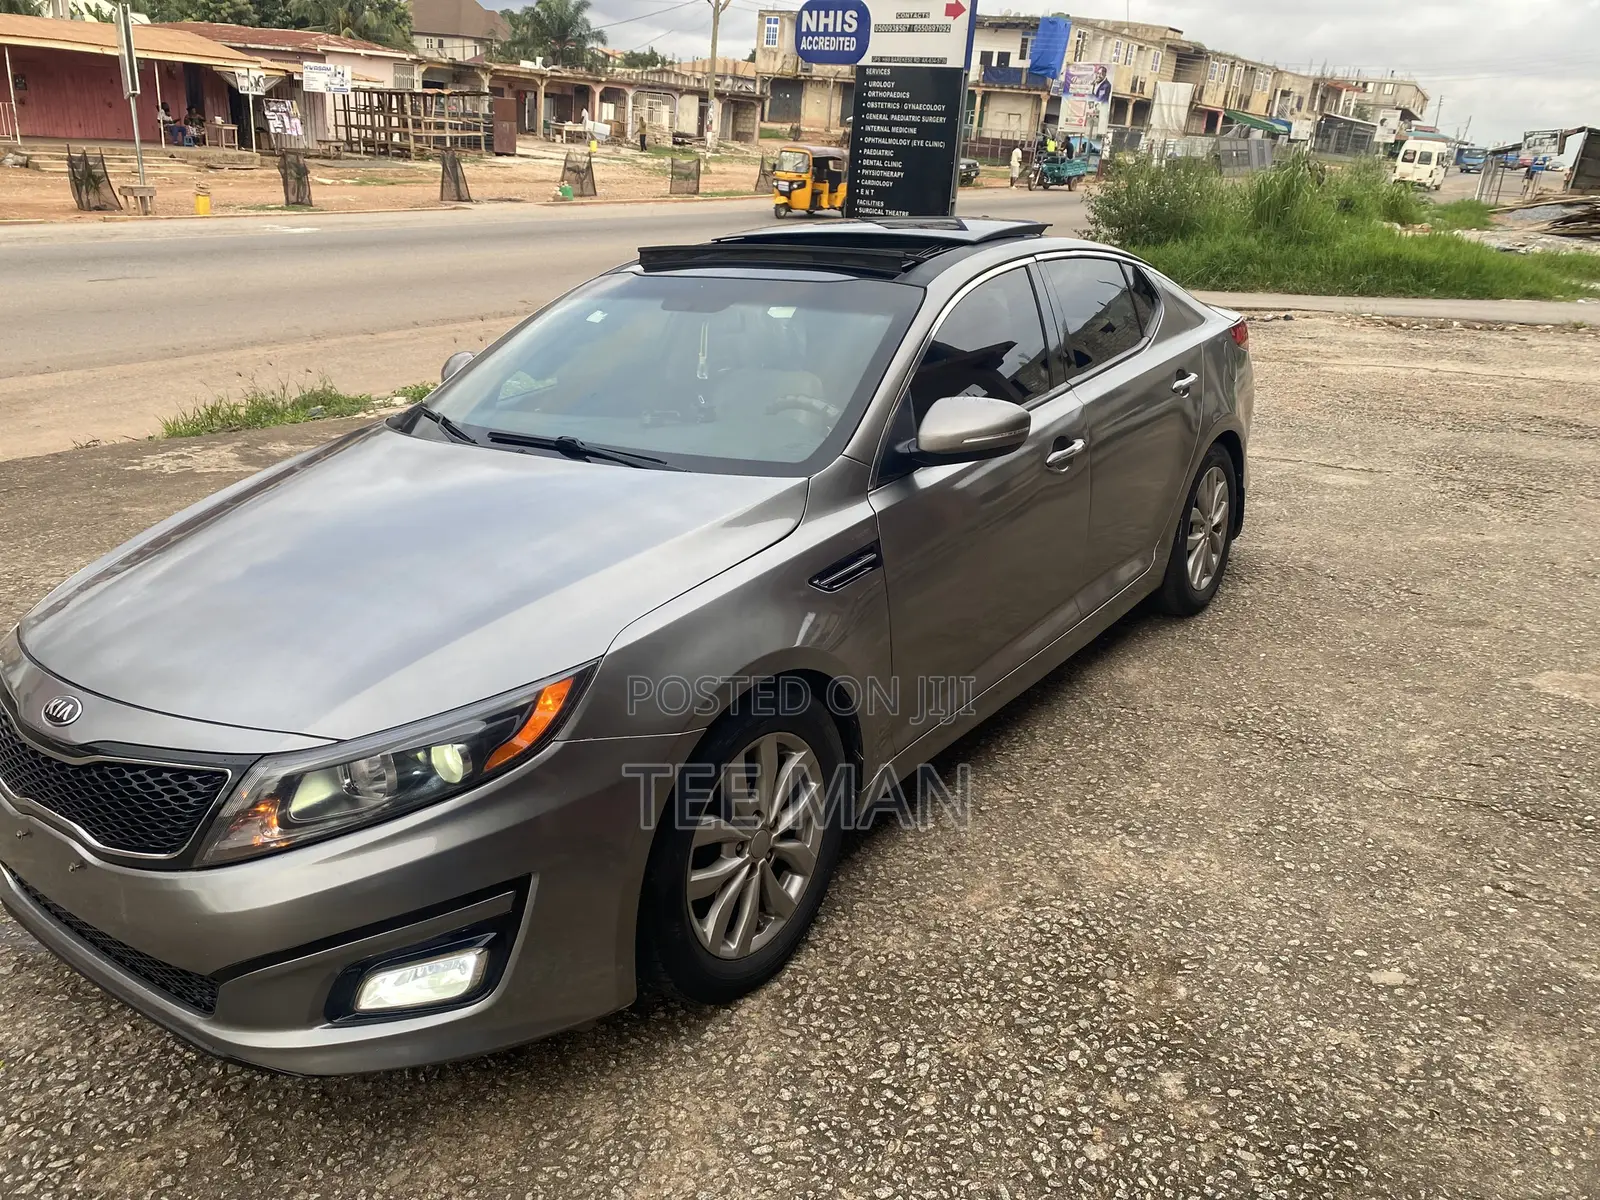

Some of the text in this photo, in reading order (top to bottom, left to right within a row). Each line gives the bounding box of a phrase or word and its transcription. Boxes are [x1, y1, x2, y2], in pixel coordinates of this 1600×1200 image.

[801, 10, 858, 33] NHIS
[800, 36, 856, 51] ACCREDITED
[904, 103, 946, 111] GYNAECOLOGY
[864, 137, 946, 149] OPHTHALMOLOGY (EYE CLINIC)
[862, 169, 904, 178] PHYSIOTHERAPY
[859, 207, 884, 215] SURGICAL
